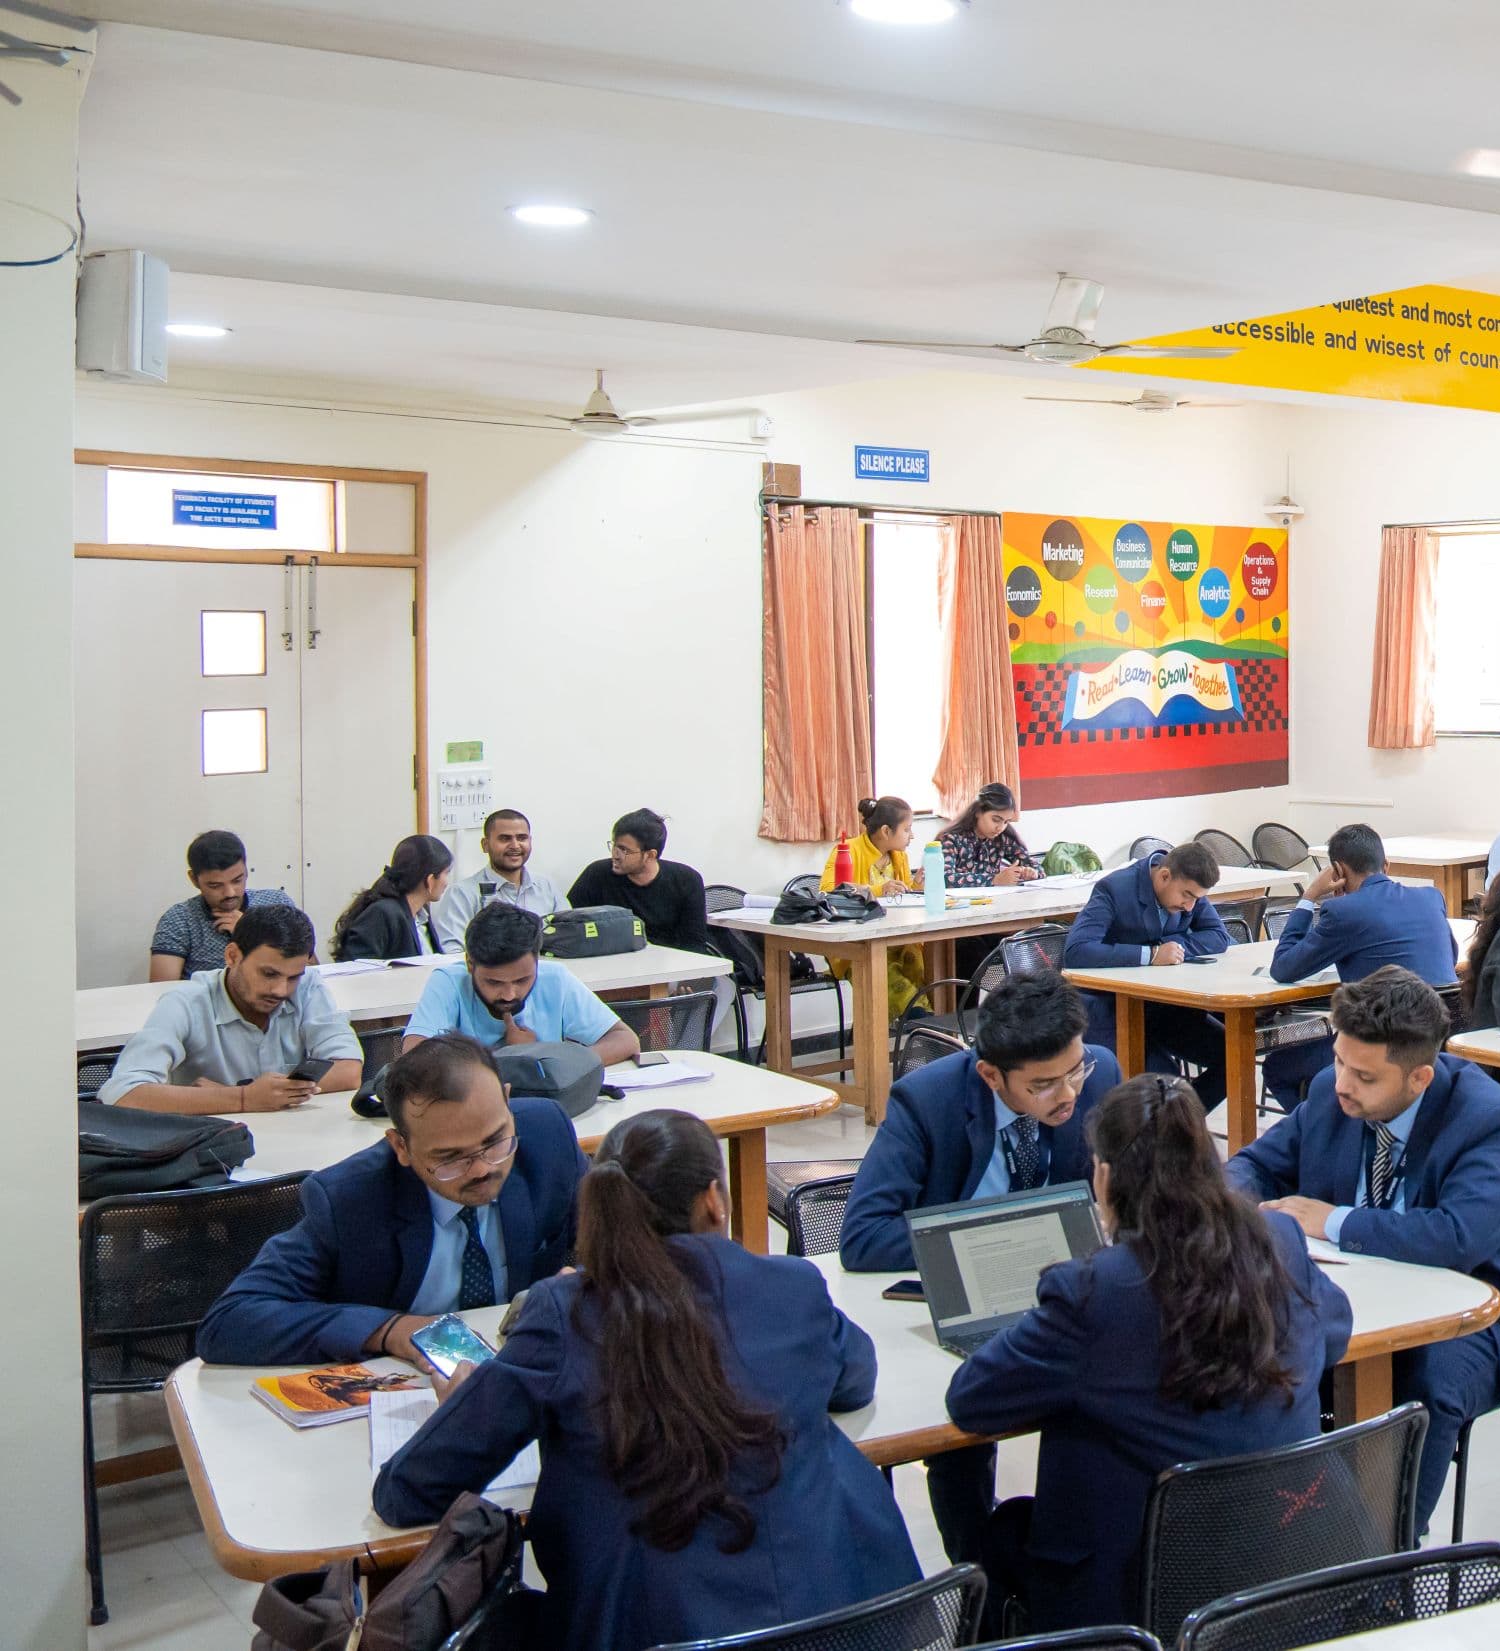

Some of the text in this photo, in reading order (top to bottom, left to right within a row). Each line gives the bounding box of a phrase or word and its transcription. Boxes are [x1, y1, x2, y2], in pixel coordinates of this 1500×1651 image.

[1401, 302, 1429, 323] and
[1433, 308, 1473, 329] most
[1324, 330, 1357, 351] and
[1365, 334, 1425, 360] wisest
[1434, 343, 1452, 363] of
[860, 454, 925, 474] SILENCE PLEASE
[1116, 539, 1146, 553] Business
[1171, 541, 1193, 555] Human
[1042, 542, 1084, 566] Marketing
[1243, 554, 1275, 568] Operations
[1169, 558, 1198, 573] Resource
[1251, 576, 1271, 588] Supply
[1006, 586, 1042, 602] Economics
[1084, 584, 1118, 599] Research
[1200, 585, 1231, 603] Analytics
[1251, 586, 1269, 597] Chain
[1140, 594, 1168, 608] Finance
[1088, 676, 1114, 705] Read
[1118, 664, 1151, 687] Learn
[1192, 665, 1229, 697] Together
